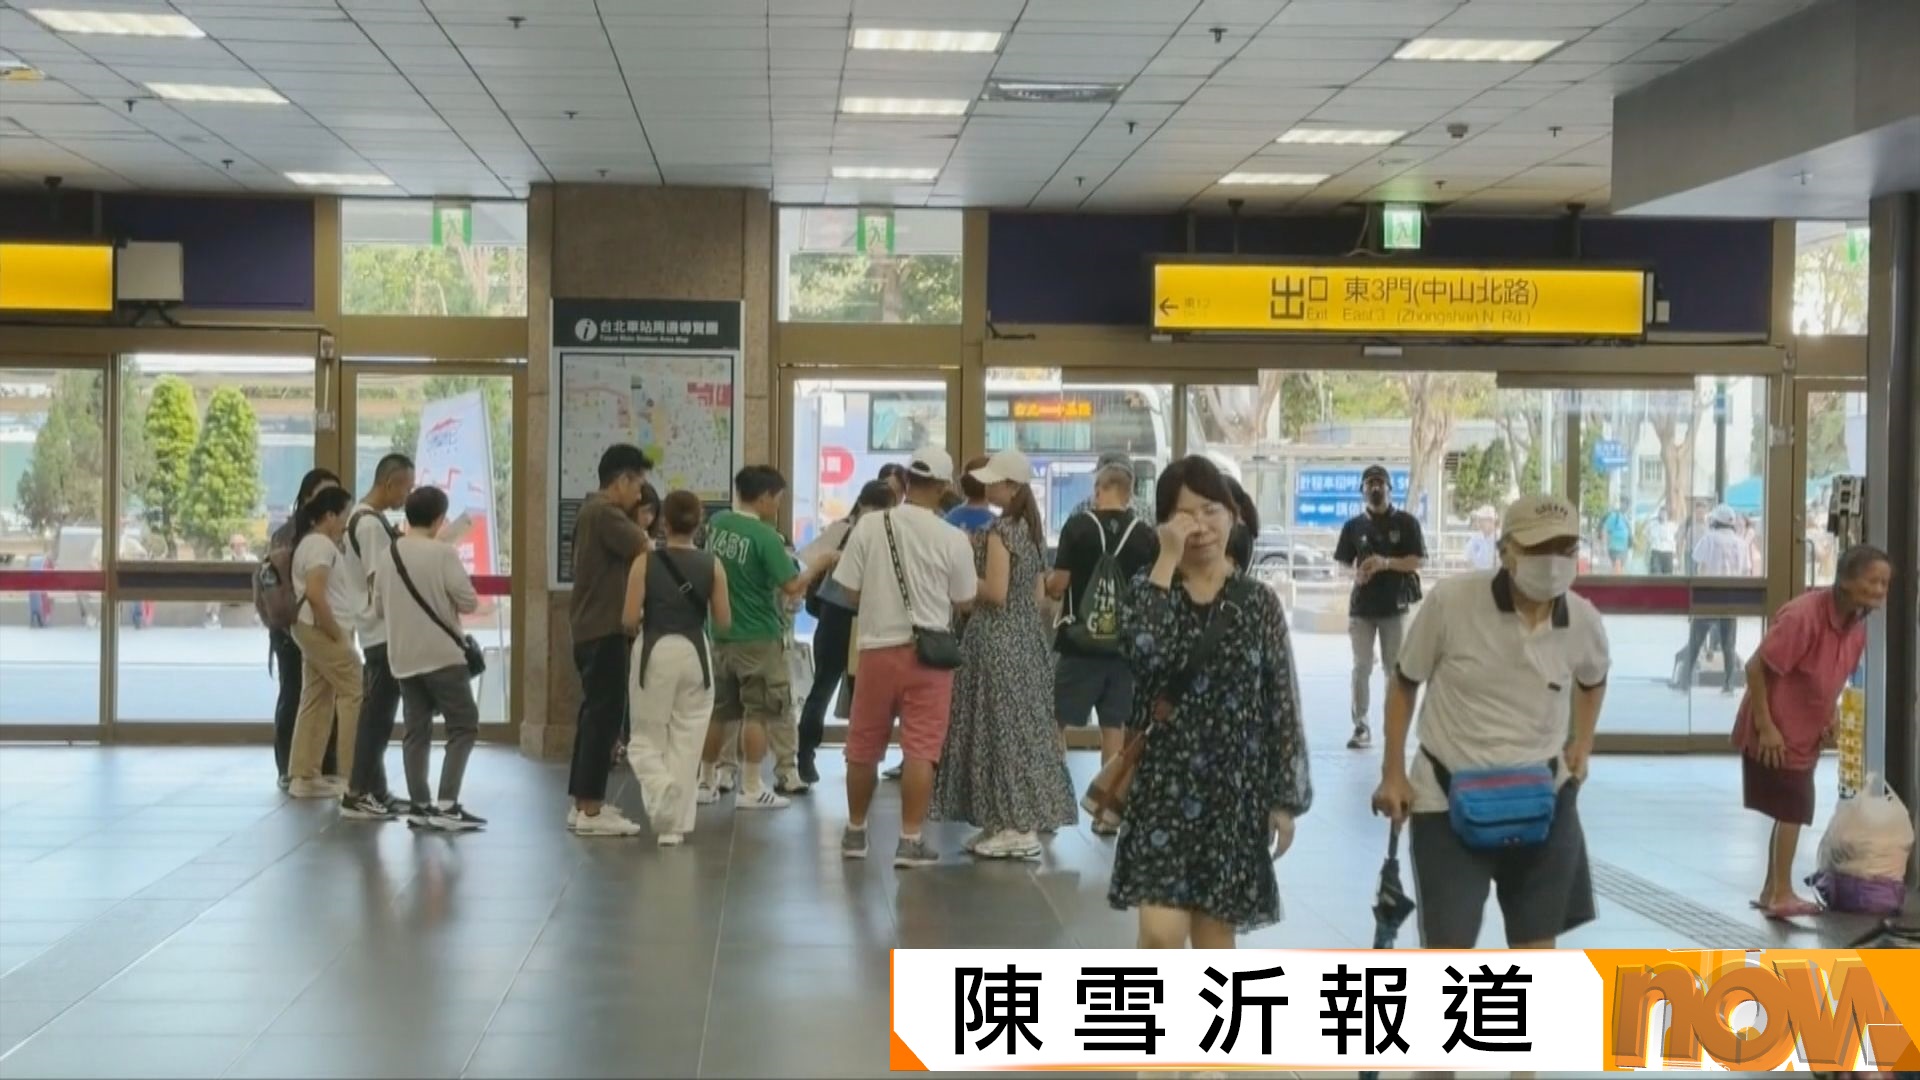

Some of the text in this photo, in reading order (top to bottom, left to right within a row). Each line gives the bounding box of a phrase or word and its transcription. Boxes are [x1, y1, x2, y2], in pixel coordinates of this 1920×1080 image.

[1270, 275, 1329, 320] 出口
[1344, 275, 1539, 309] 東3門(中山北路)
[1306, 306, 1328, 321] Exit
[1342, 307, 1373, 322] East
[1397, 307, 1479, 326] (Zhongshan
